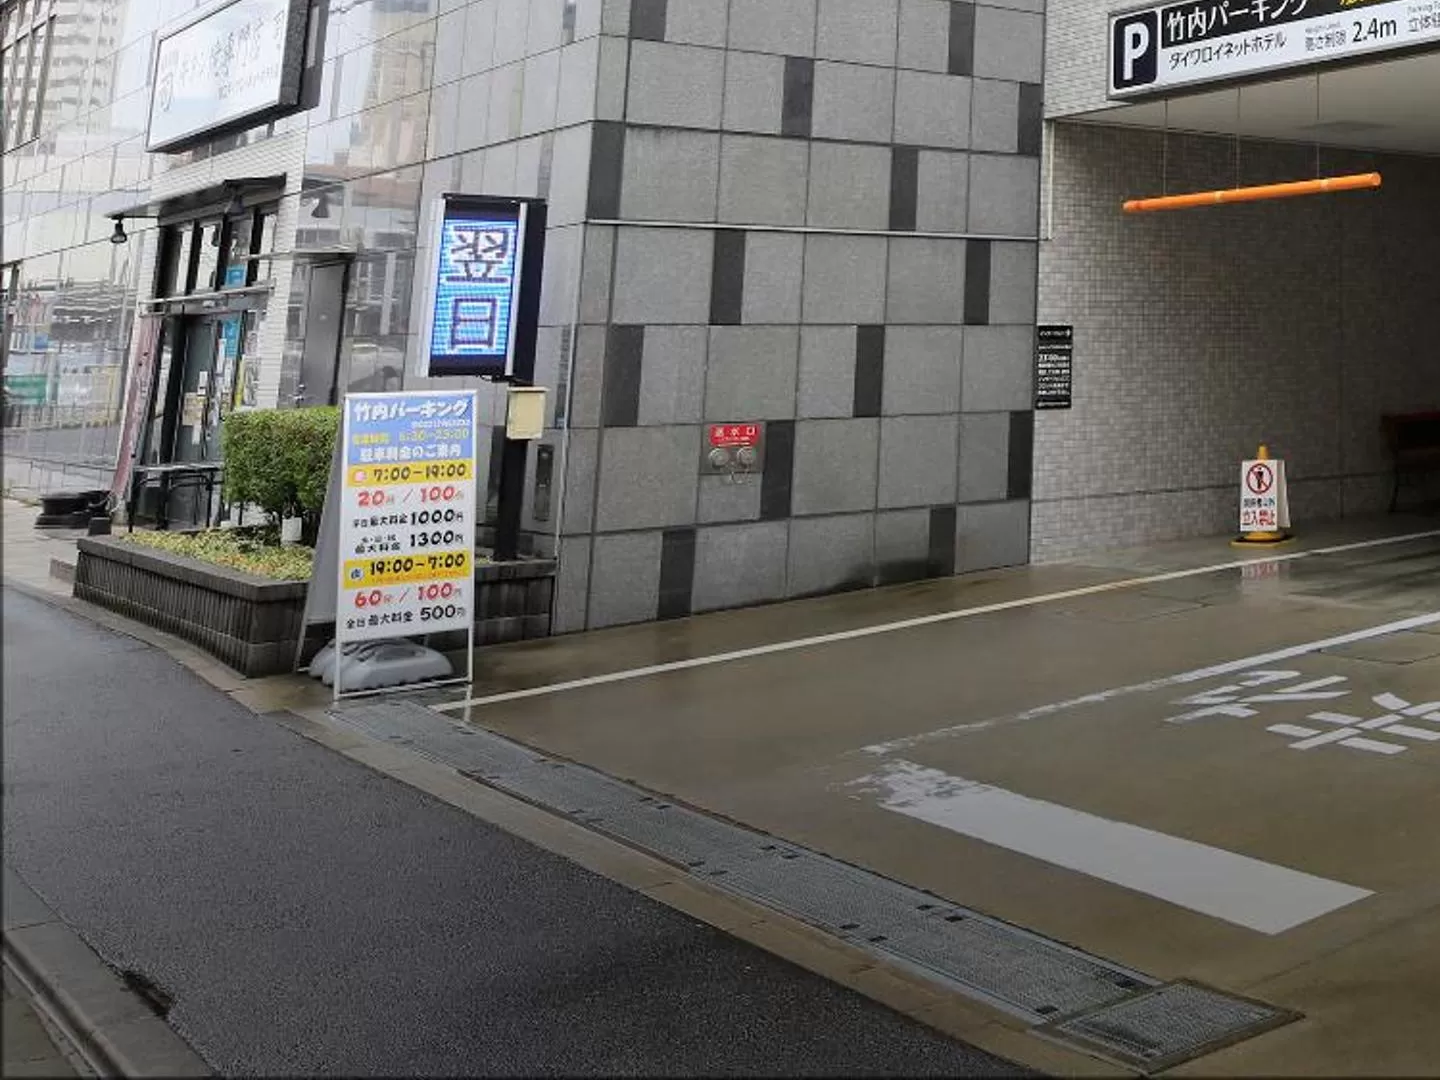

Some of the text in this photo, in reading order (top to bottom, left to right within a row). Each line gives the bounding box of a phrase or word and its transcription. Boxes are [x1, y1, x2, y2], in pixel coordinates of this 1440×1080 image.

[1123, 22, 1150, 80] P
[1168, 30, 1288, 71] ダイワロイネットホテル
[1353, 18, 1397, 43] 2.4m
[444, 224, 510, 350] 翌日
[354, 399, 470, 422] 竹内パーキング
